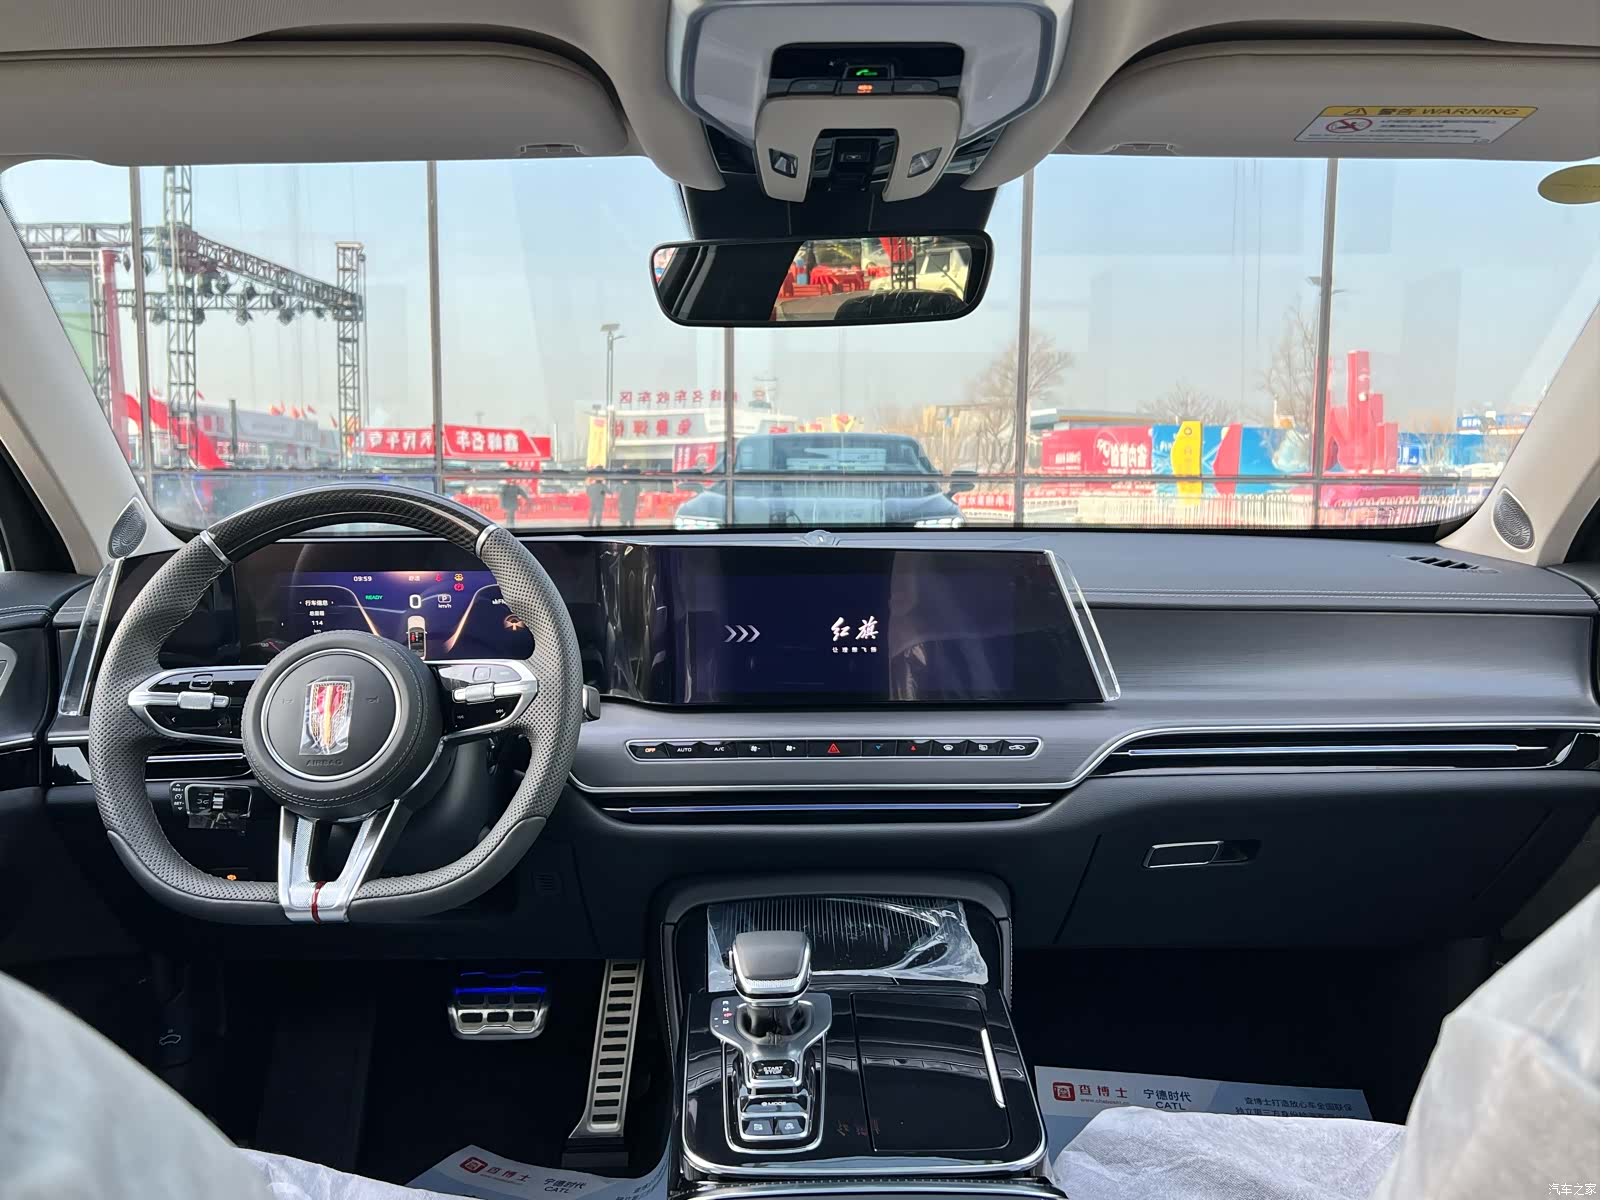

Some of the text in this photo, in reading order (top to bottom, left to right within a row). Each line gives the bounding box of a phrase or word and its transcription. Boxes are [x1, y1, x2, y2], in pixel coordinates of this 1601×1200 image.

[1422, 108, 1520, 116] WARNING
[409, 594, 422, 609] 0
[831, 615, 879, 642] 红旗
[306, 759, 345, 767] AIRBAG
[1080, 1083, 1128, 1099] 查博士
[1143, 1088, 1192, 1103] 宁德时代
[1155, 1101, 1187, 1111] CATL
[543, 1186, 570, 1194] CATL
